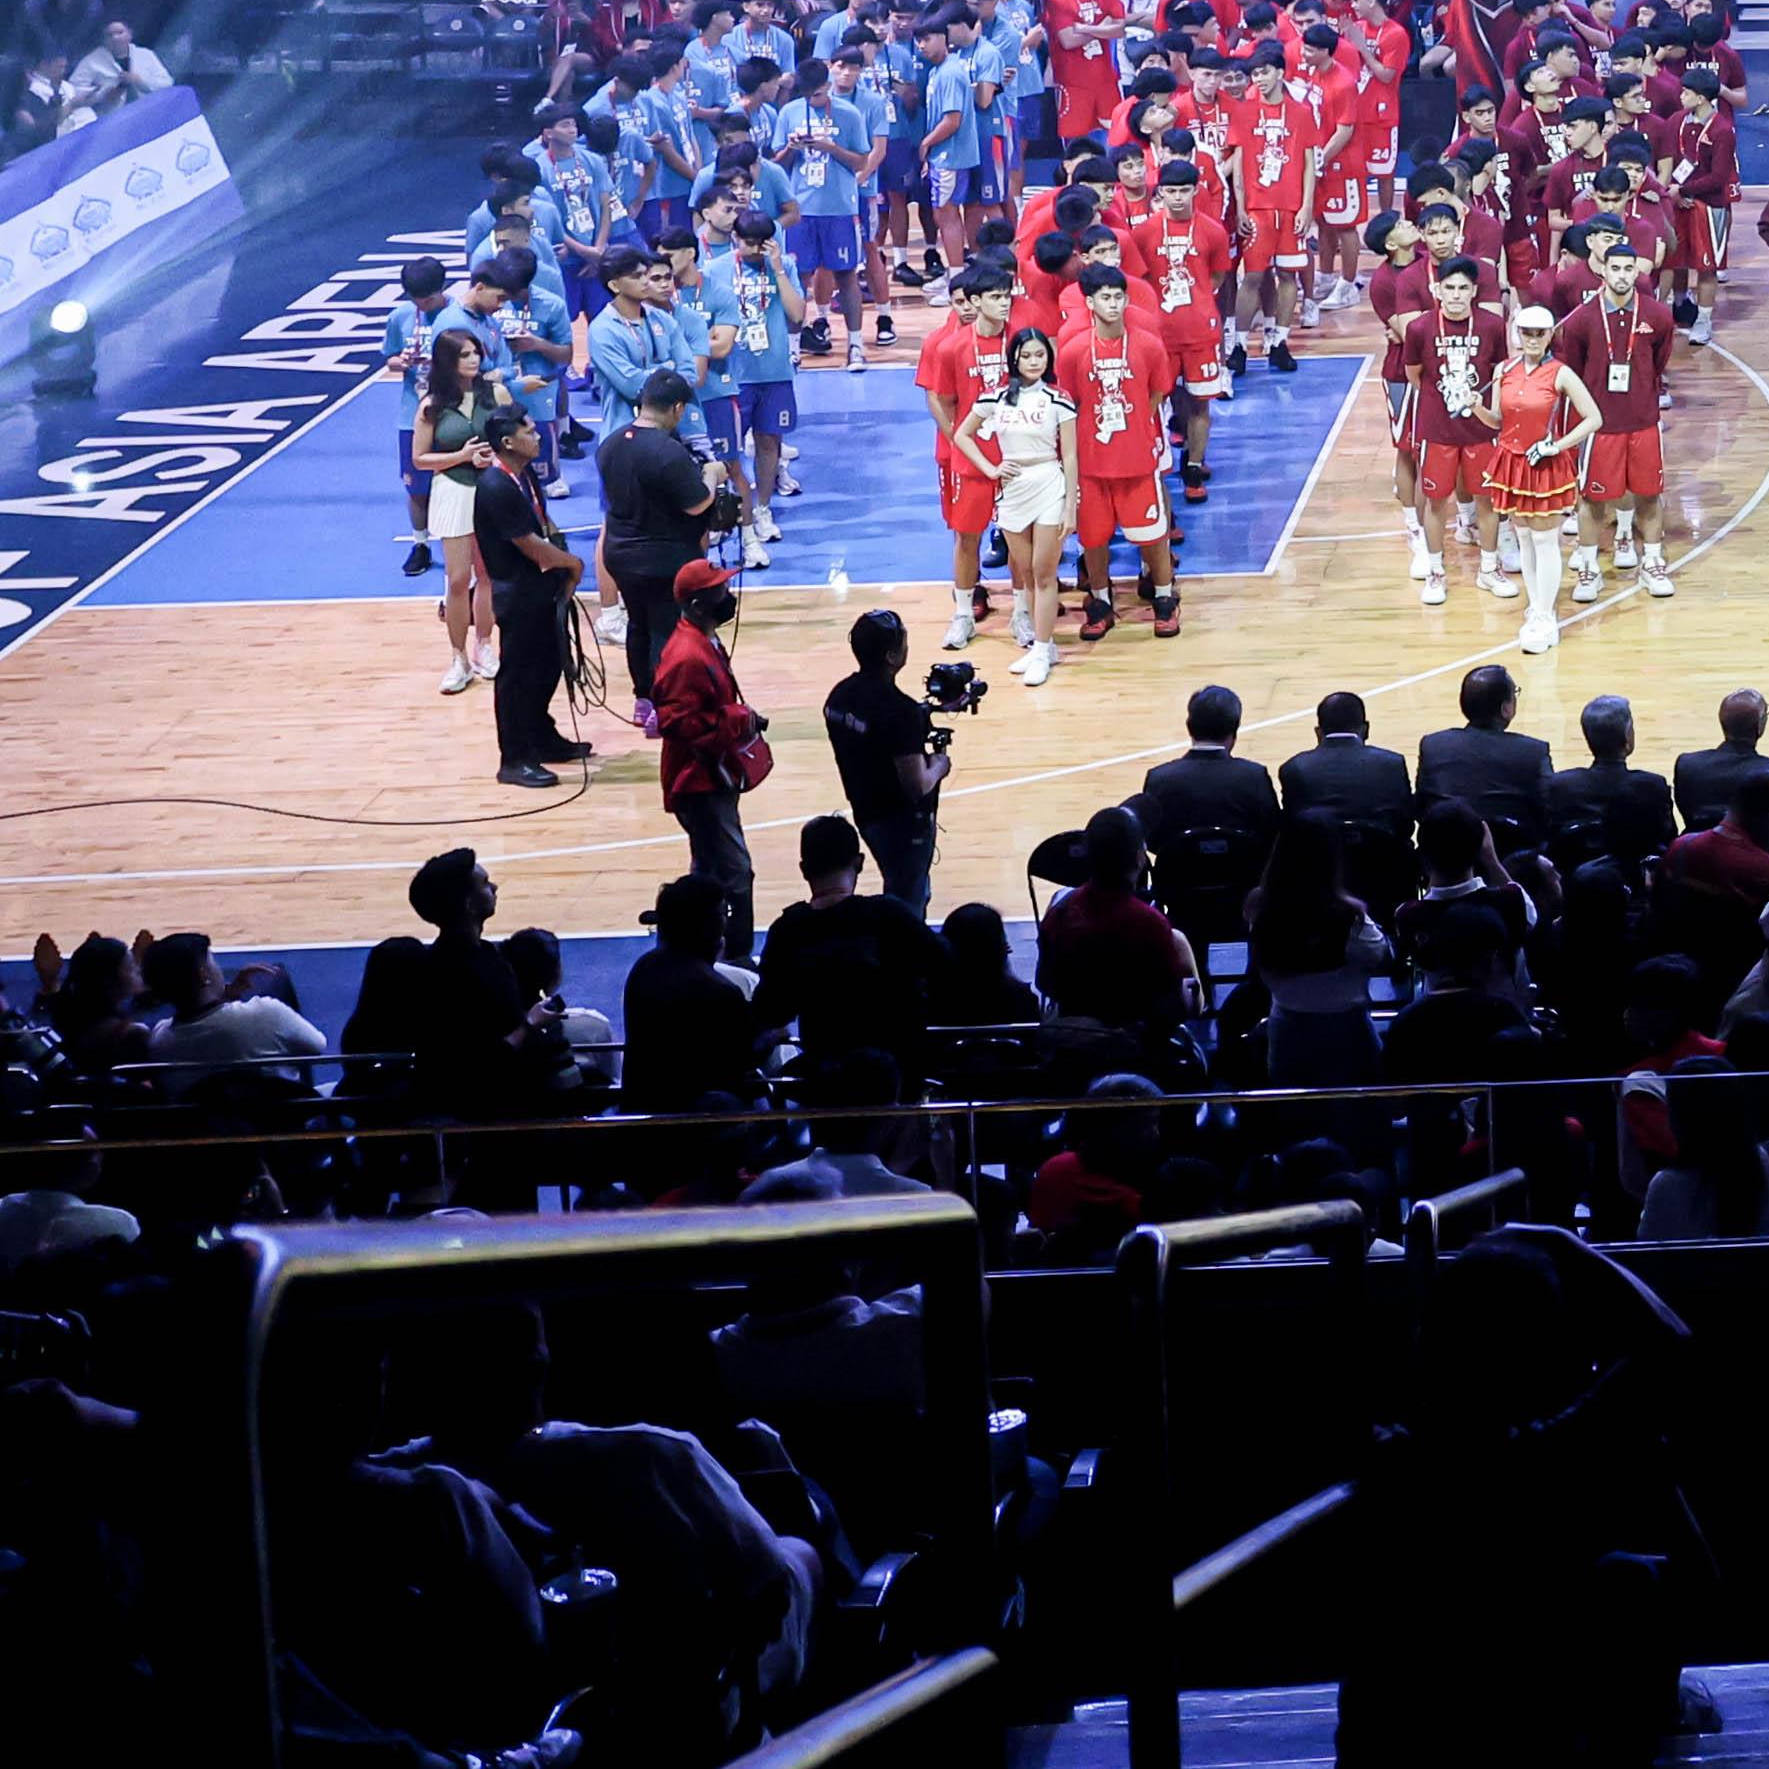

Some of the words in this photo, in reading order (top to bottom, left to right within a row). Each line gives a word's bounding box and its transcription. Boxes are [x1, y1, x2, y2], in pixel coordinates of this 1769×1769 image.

[1372, 149, 1389, 160] 24
[1326, 199, 1344, 210] 41
[1200, 362, 1219, 378] 19
[779, 410, 790, 426] 8
[0, 395, 330, 524] ASIA
[1145, 505, 1159, 520] 4
